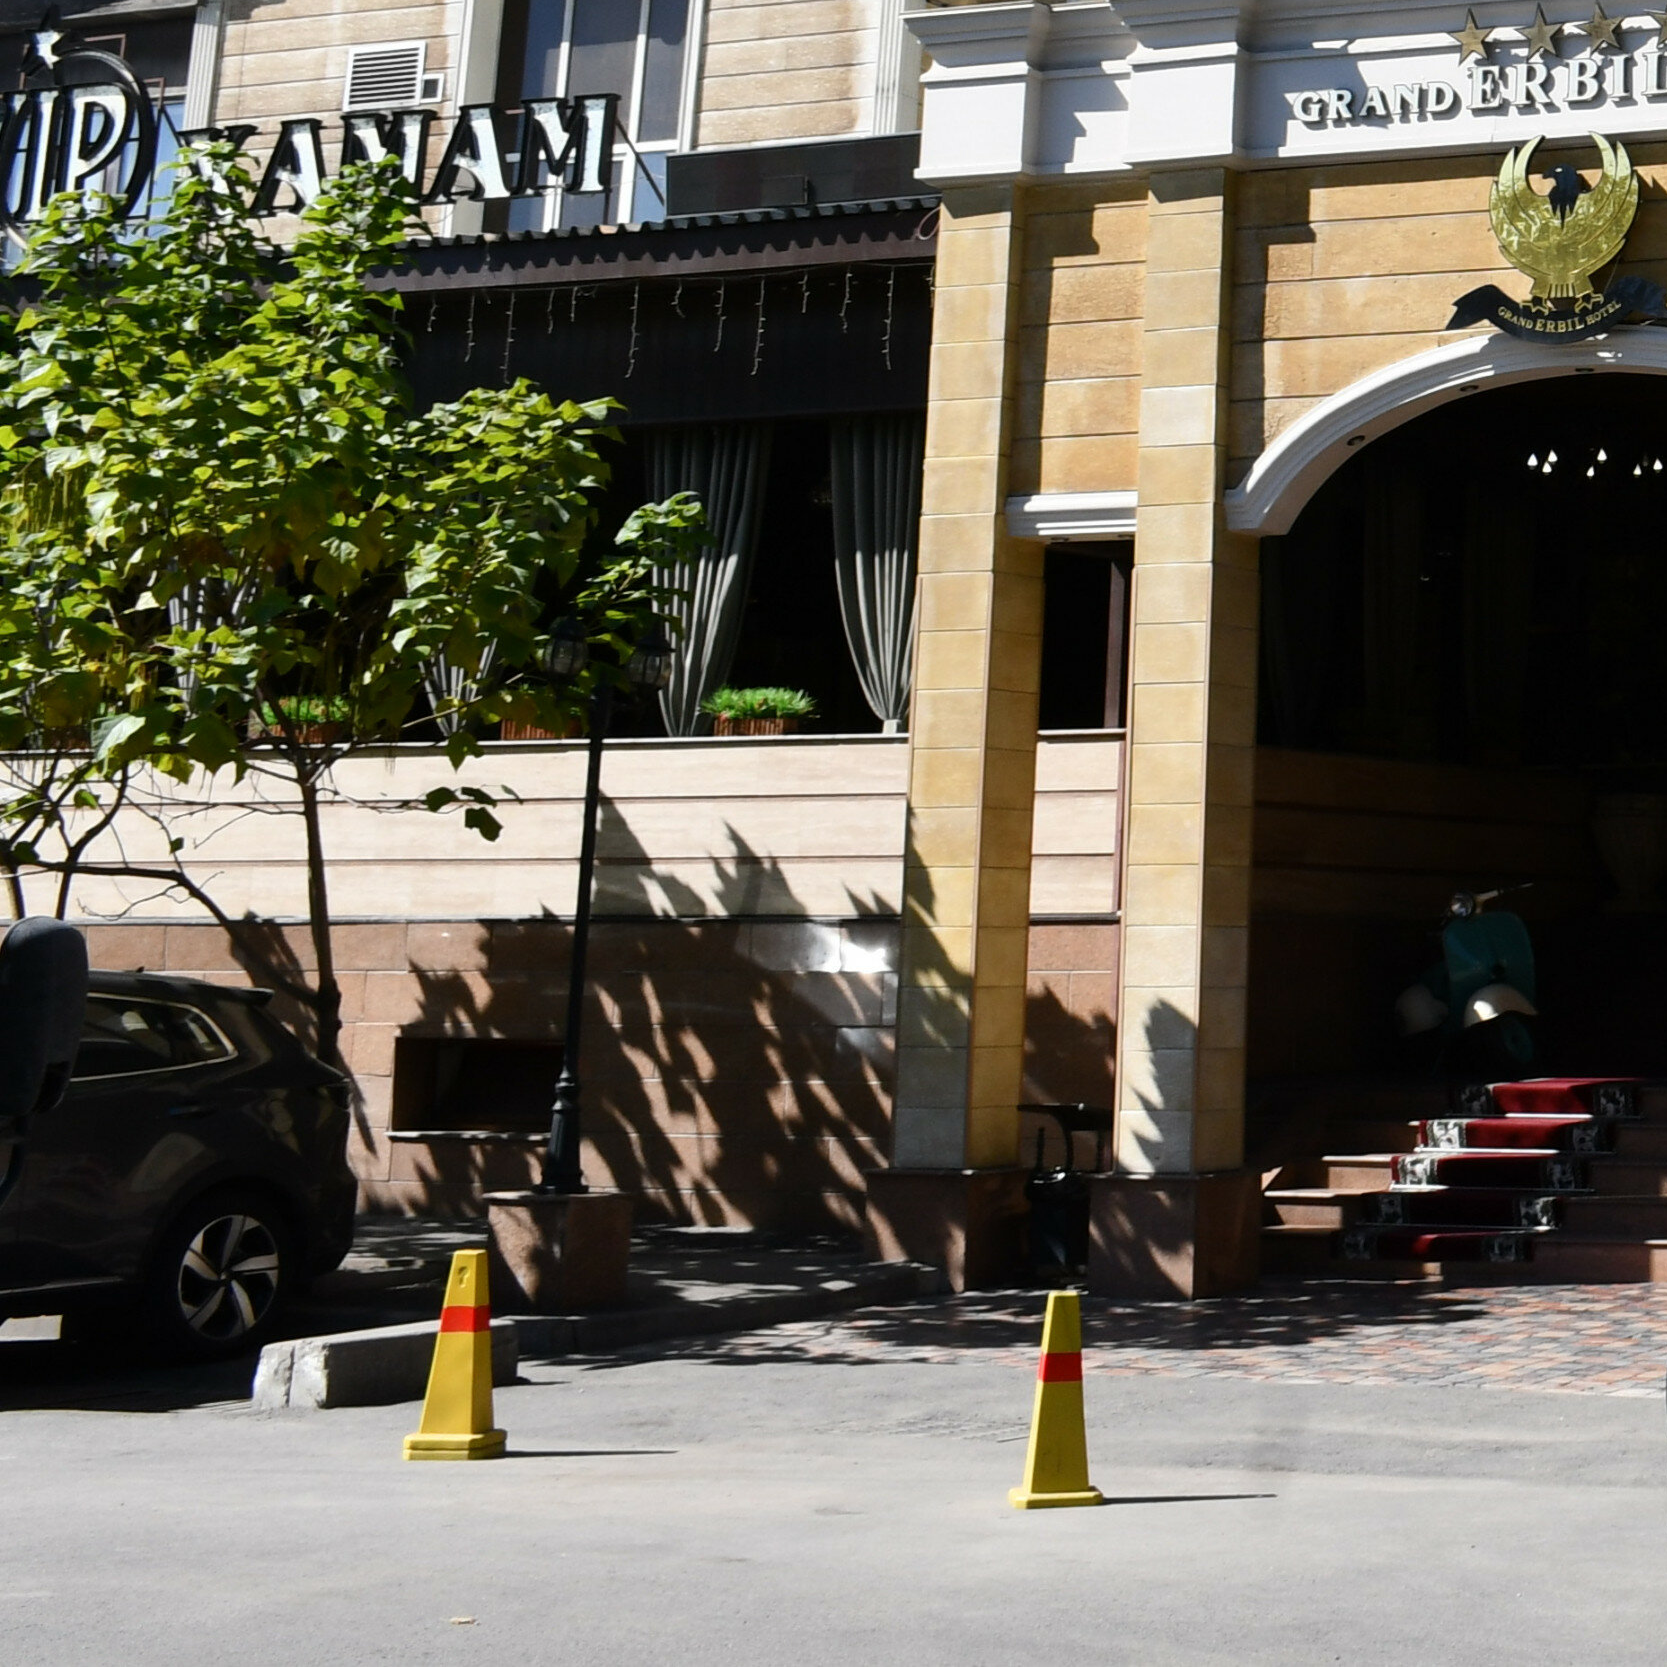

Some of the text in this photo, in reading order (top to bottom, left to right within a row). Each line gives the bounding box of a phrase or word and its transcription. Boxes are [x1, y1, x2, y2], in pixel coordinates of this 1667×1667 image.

[1293, 80, 1457, 123] GRAND
[1498, 300, 1622, 333] GRAND ERBIL HOTEL
